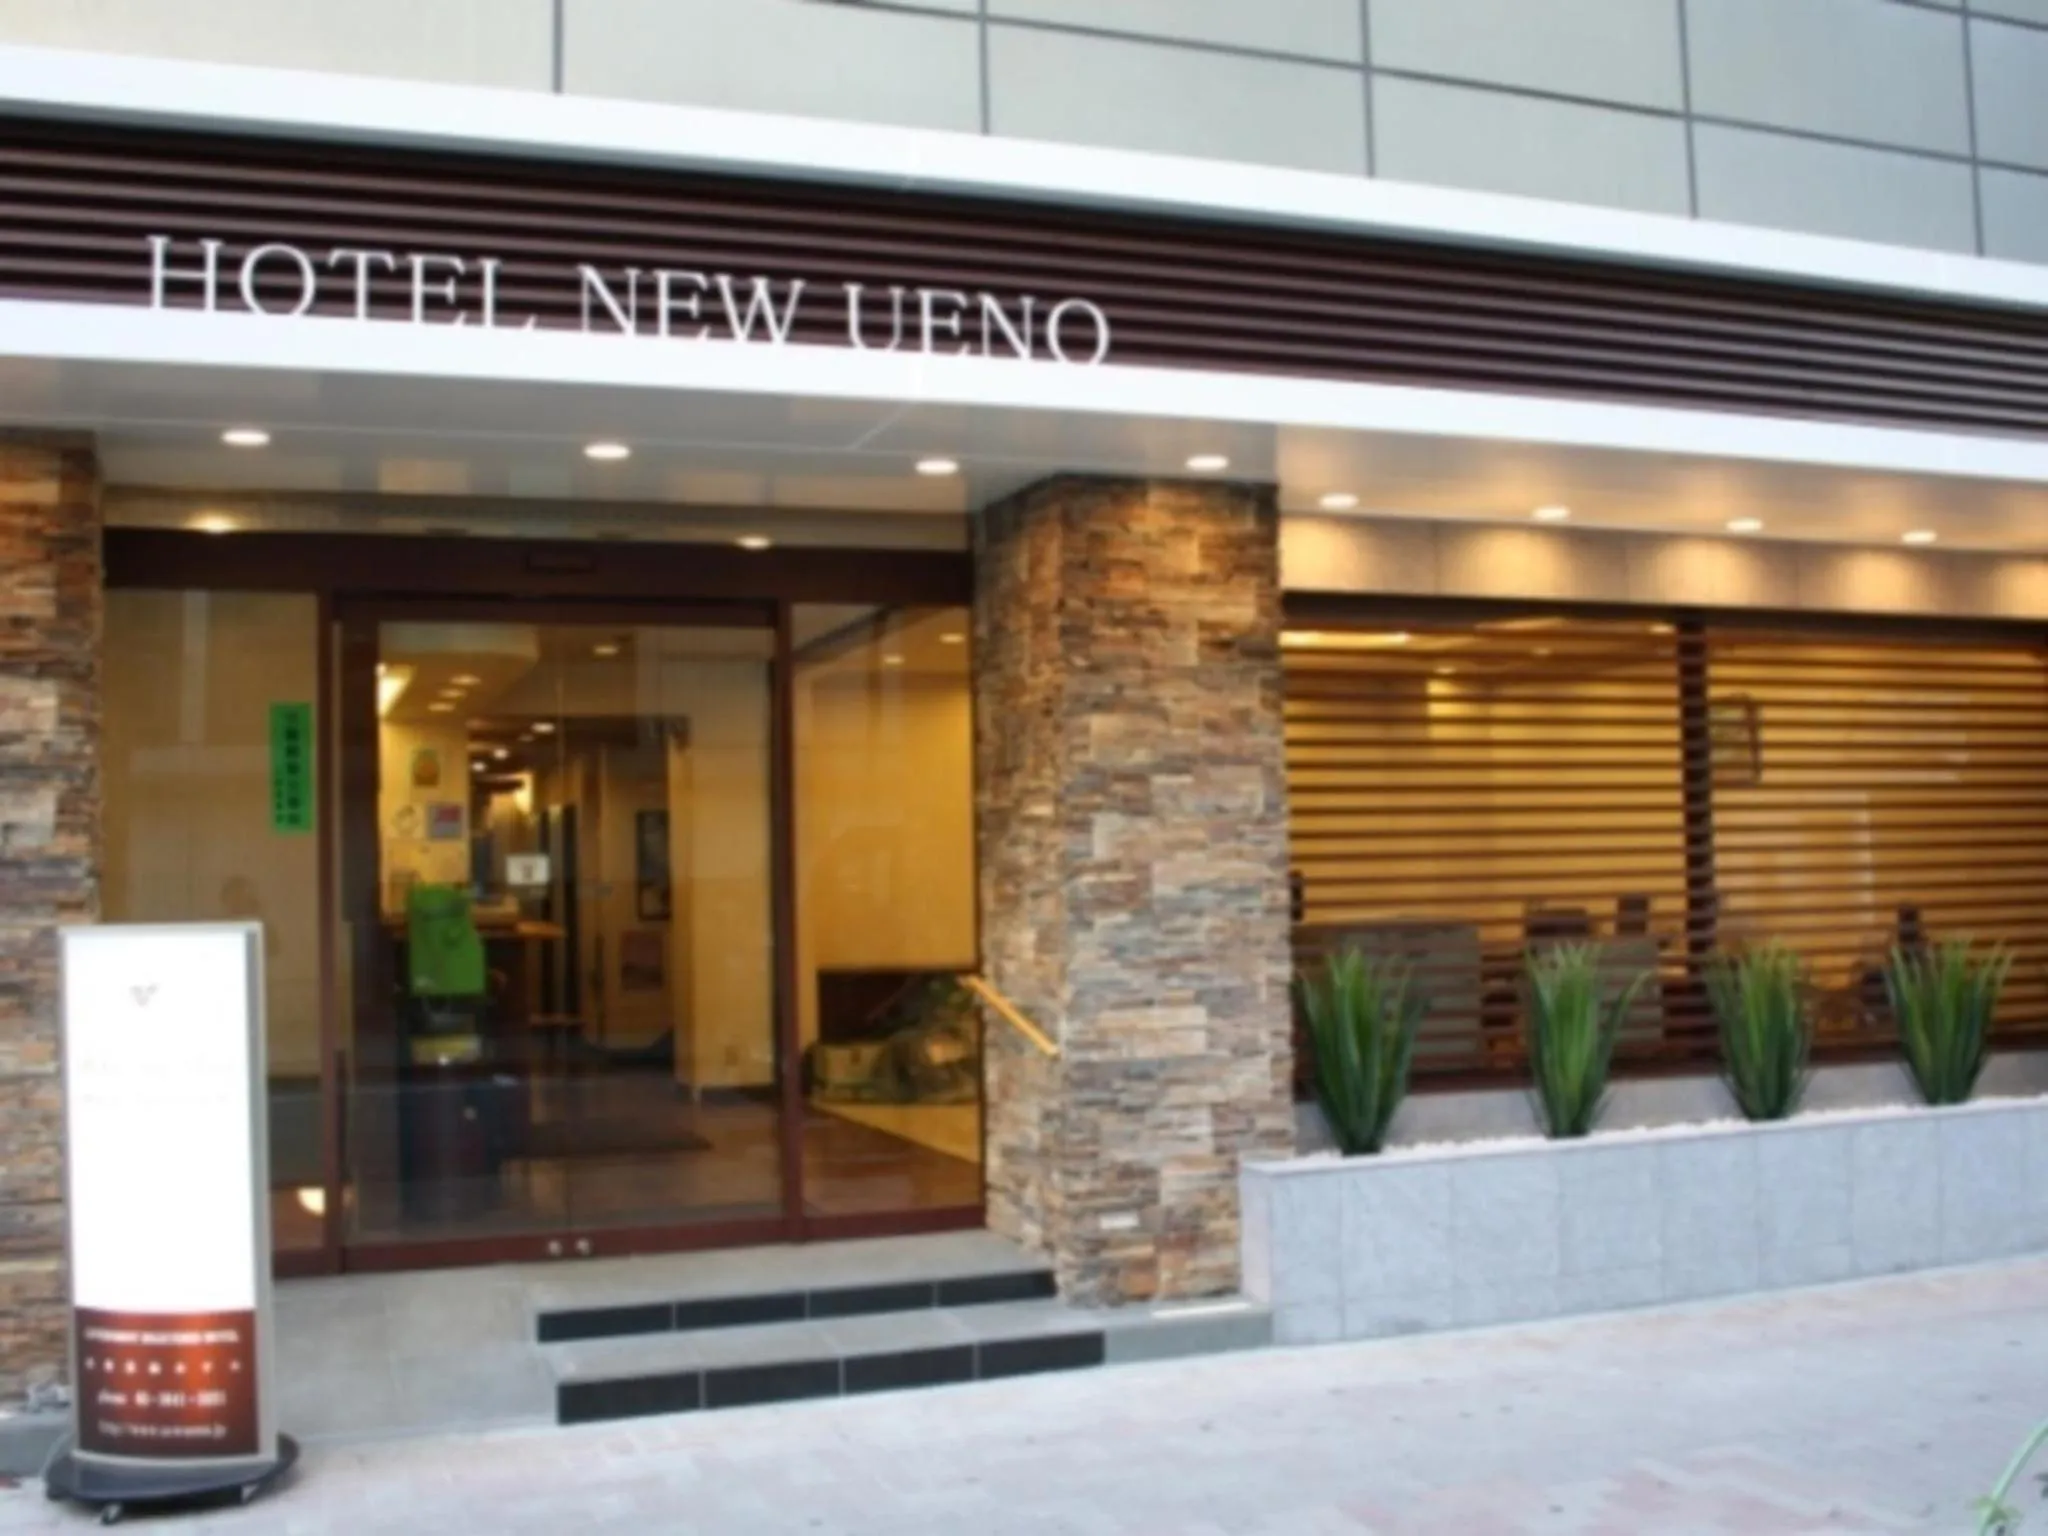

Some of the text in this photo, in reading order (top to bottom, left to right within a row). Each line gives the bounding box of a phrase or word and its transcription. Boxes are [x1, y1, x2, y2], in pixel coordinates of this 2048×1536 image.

[147, 235, 1110, 365] HOTEL NEW UENO
